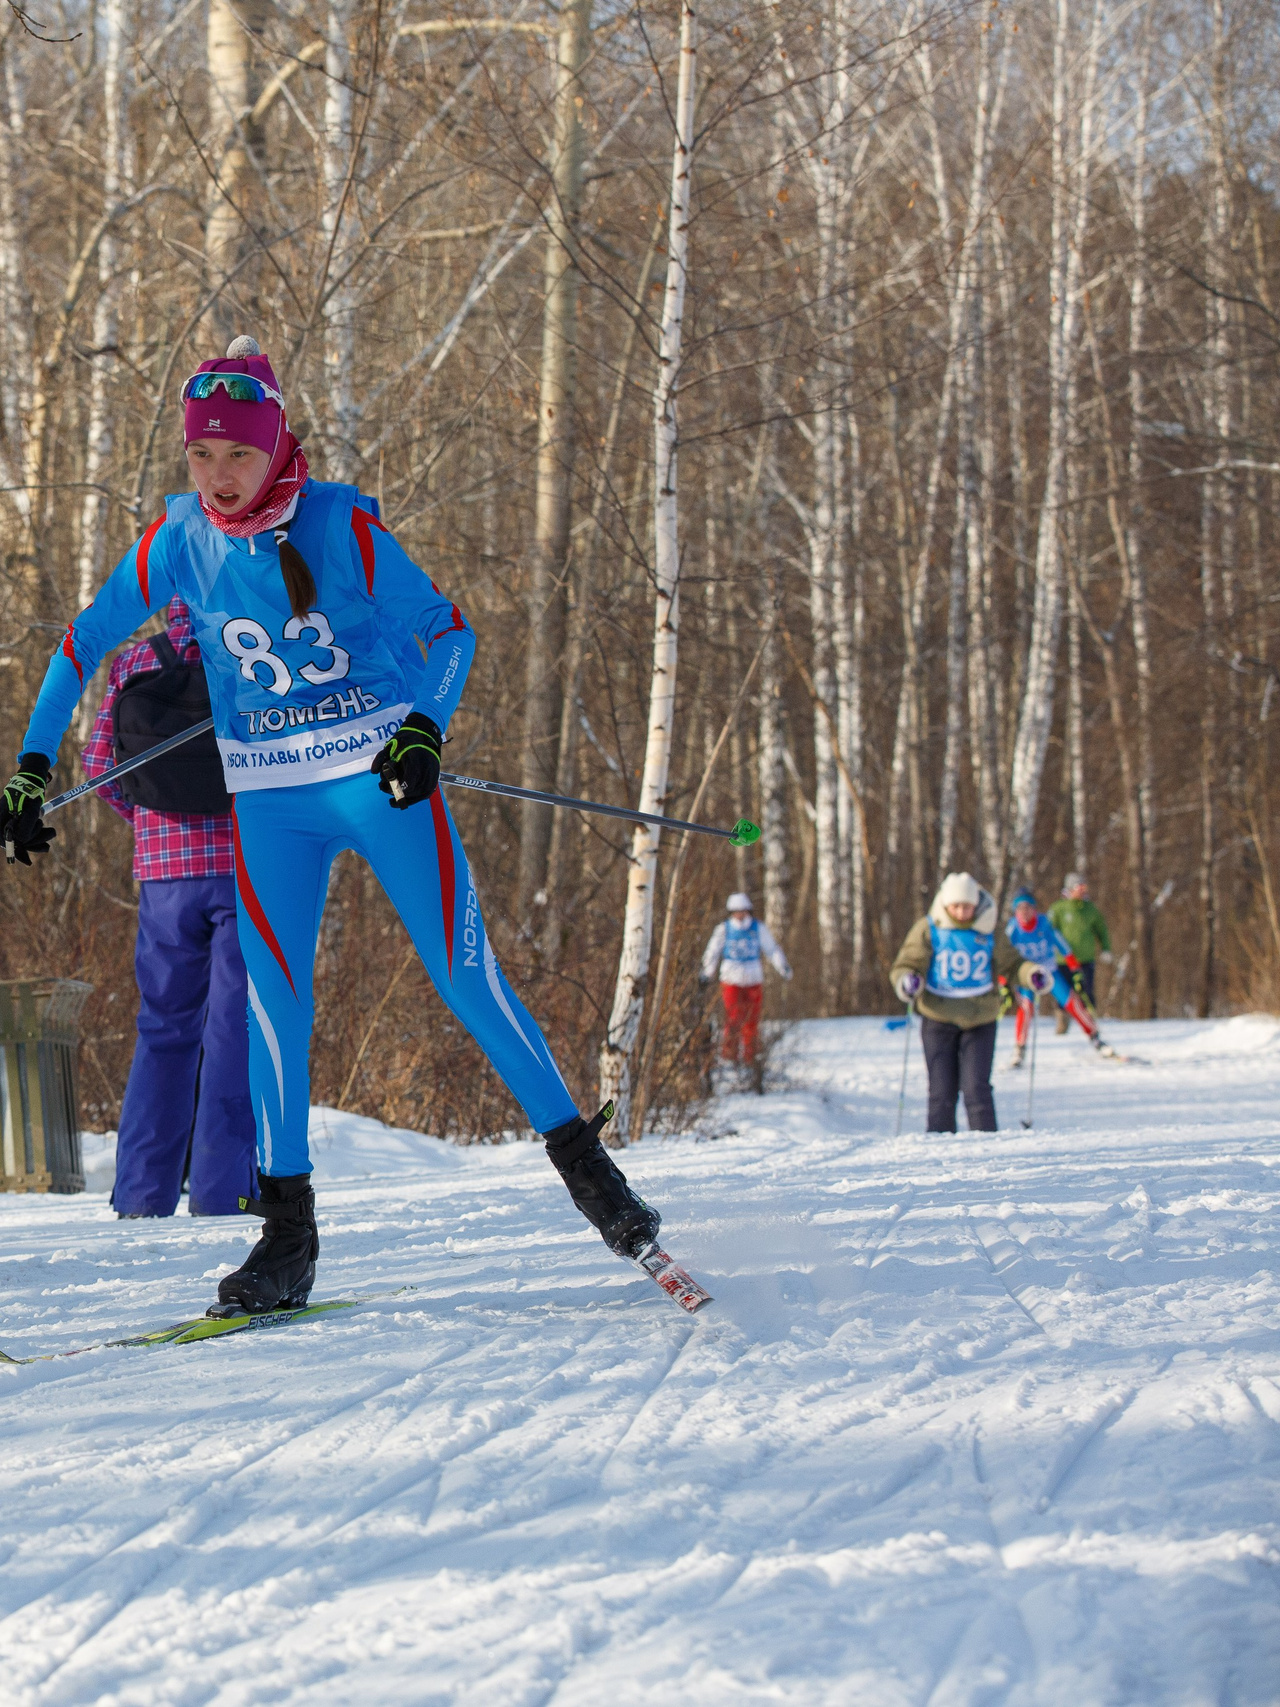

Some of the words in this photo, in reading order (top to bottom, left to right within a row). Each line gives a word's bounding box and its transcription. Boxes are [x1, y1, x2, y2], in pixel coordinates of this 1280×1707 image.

[222, 611, 351, 697] 83
[433, 645, 462, 703] NORDSKI
[240, 686, 381, 735] ТЮМЕНЬ
[251, 749, 301, 767] ГЛАВЫ
[305, 732, 372, 761] ГОРОДА
[935, 949, 988, 982] 192
